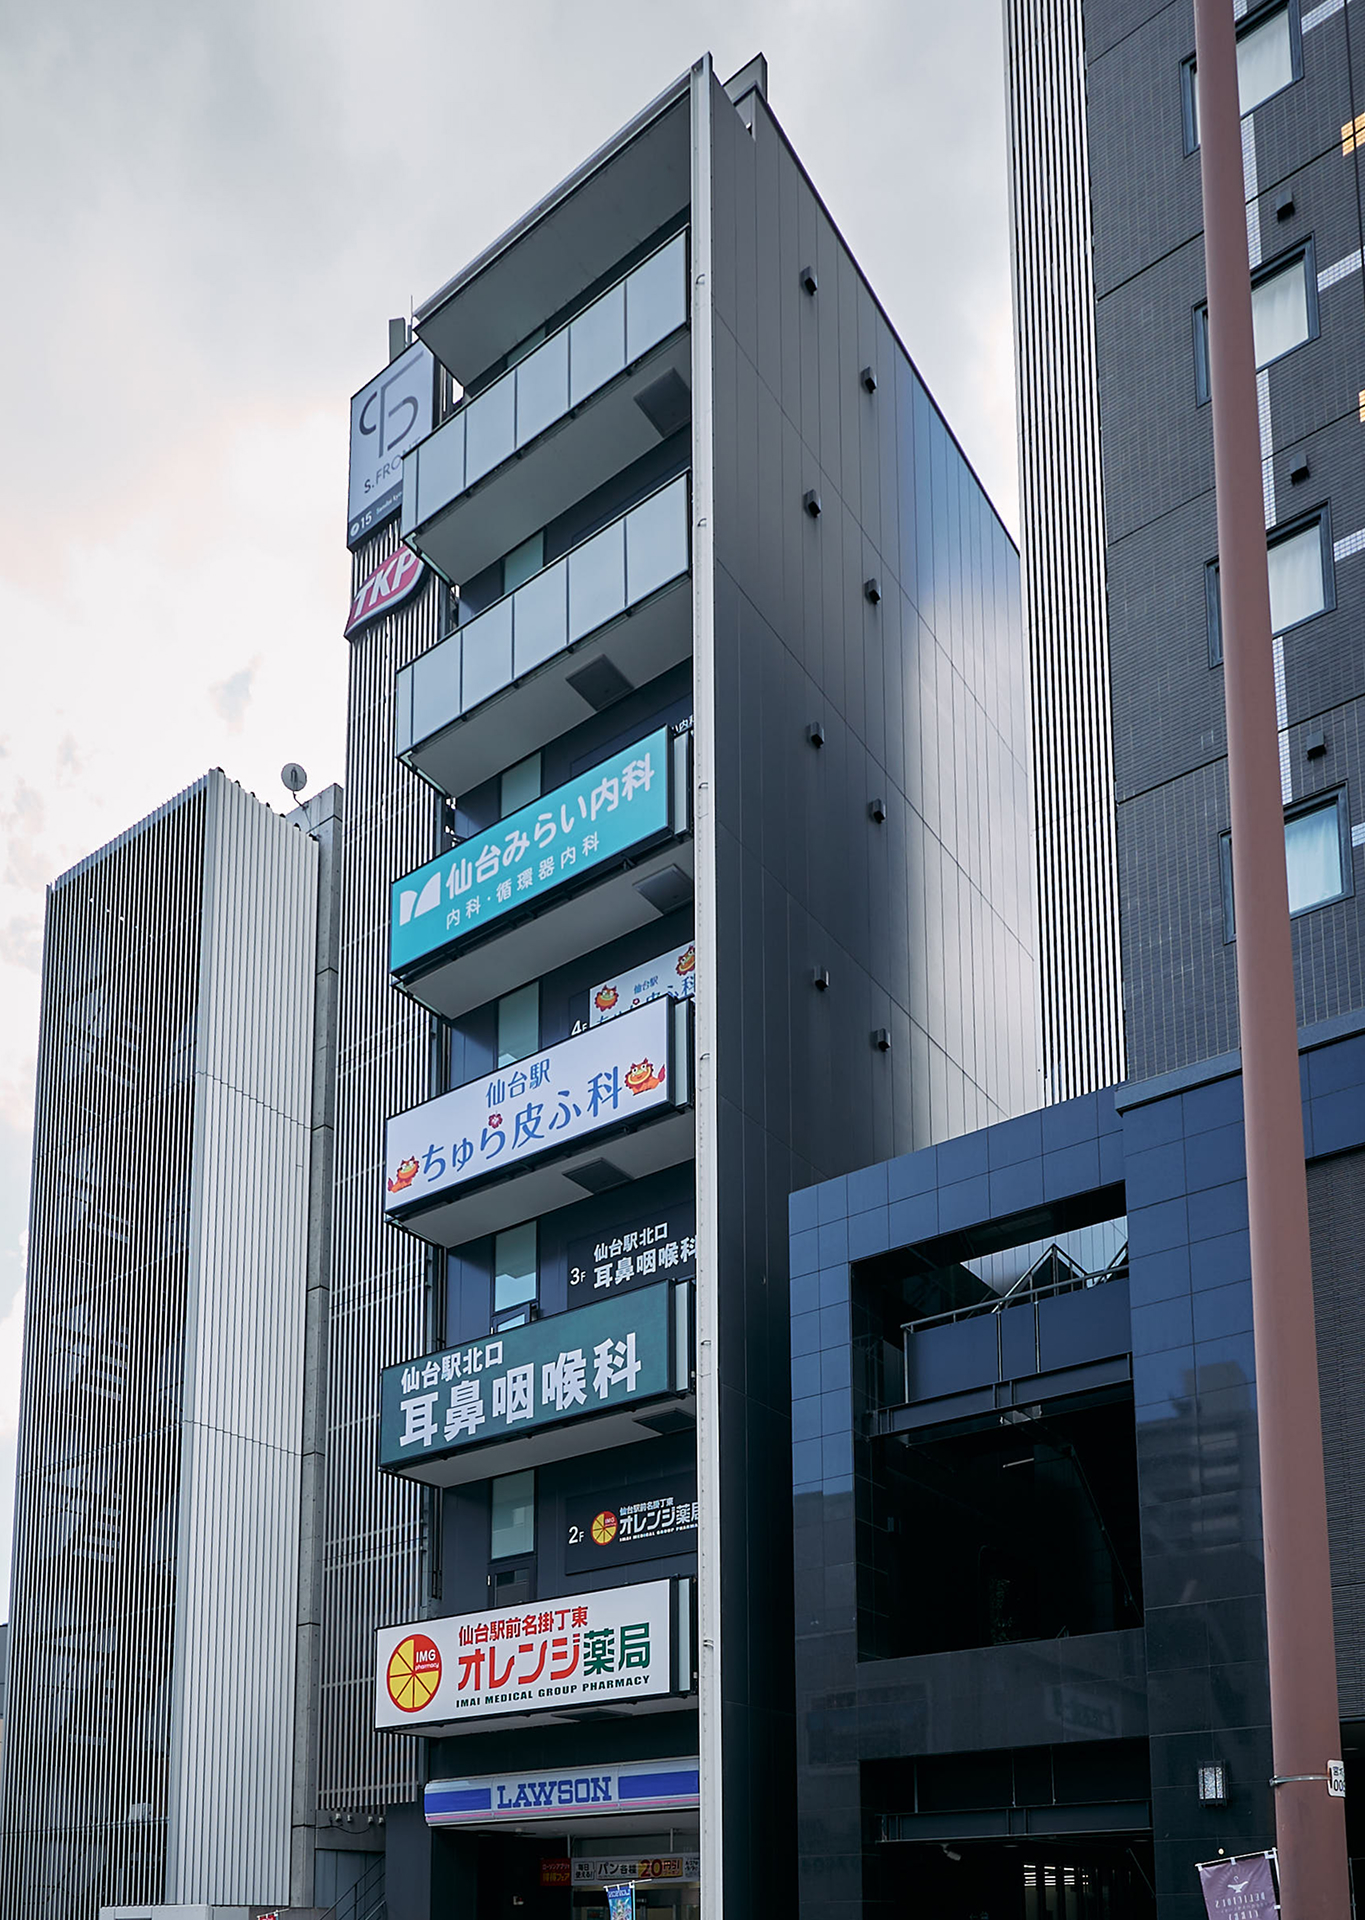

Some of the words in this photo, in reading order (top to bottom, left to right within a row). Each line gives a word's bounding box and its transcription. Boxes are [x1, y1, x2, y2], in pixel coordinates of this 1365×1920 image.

[353, 550, 420, 619] TKP
[445, 752, 655, 899] 仙台みらい内科
[634, 976, 659, 995] 仙台駅
[486, 1058, 551, 1108] 仙台駅
[421, 1065, 622, 1182] ちゅら皮ふ科
[593, 1222, 668, 1263] 仙台駅北口
[593, 1234, 698, 1289] 耳鼻咽喉科
[569, 1267, 586, 1286] 3F
[400, 1340, 503, 1394] 仙台駅北口
[399, 1332, 642, 1447] 耳鼻咽喉科
[568, 1526, 584, 1544] 2F
[458, 1606, 588, 1646] 仙台駅前名掛丁東
[415, 1662, 440, 1671] pharmacy
[416, 1649, 436, 1663] IMG
[458, 1622, 650, 1691] オレンジ薬局
[456, 1697, 481, 1708] IMAI
[485, 1690, 534, 1705] MEDICAL
[538, 1684, 578, 1698] GROUP
[582, 1675, 650, 1692] PHARMACY
[497, 1776, 612, 1809] LAWSON
